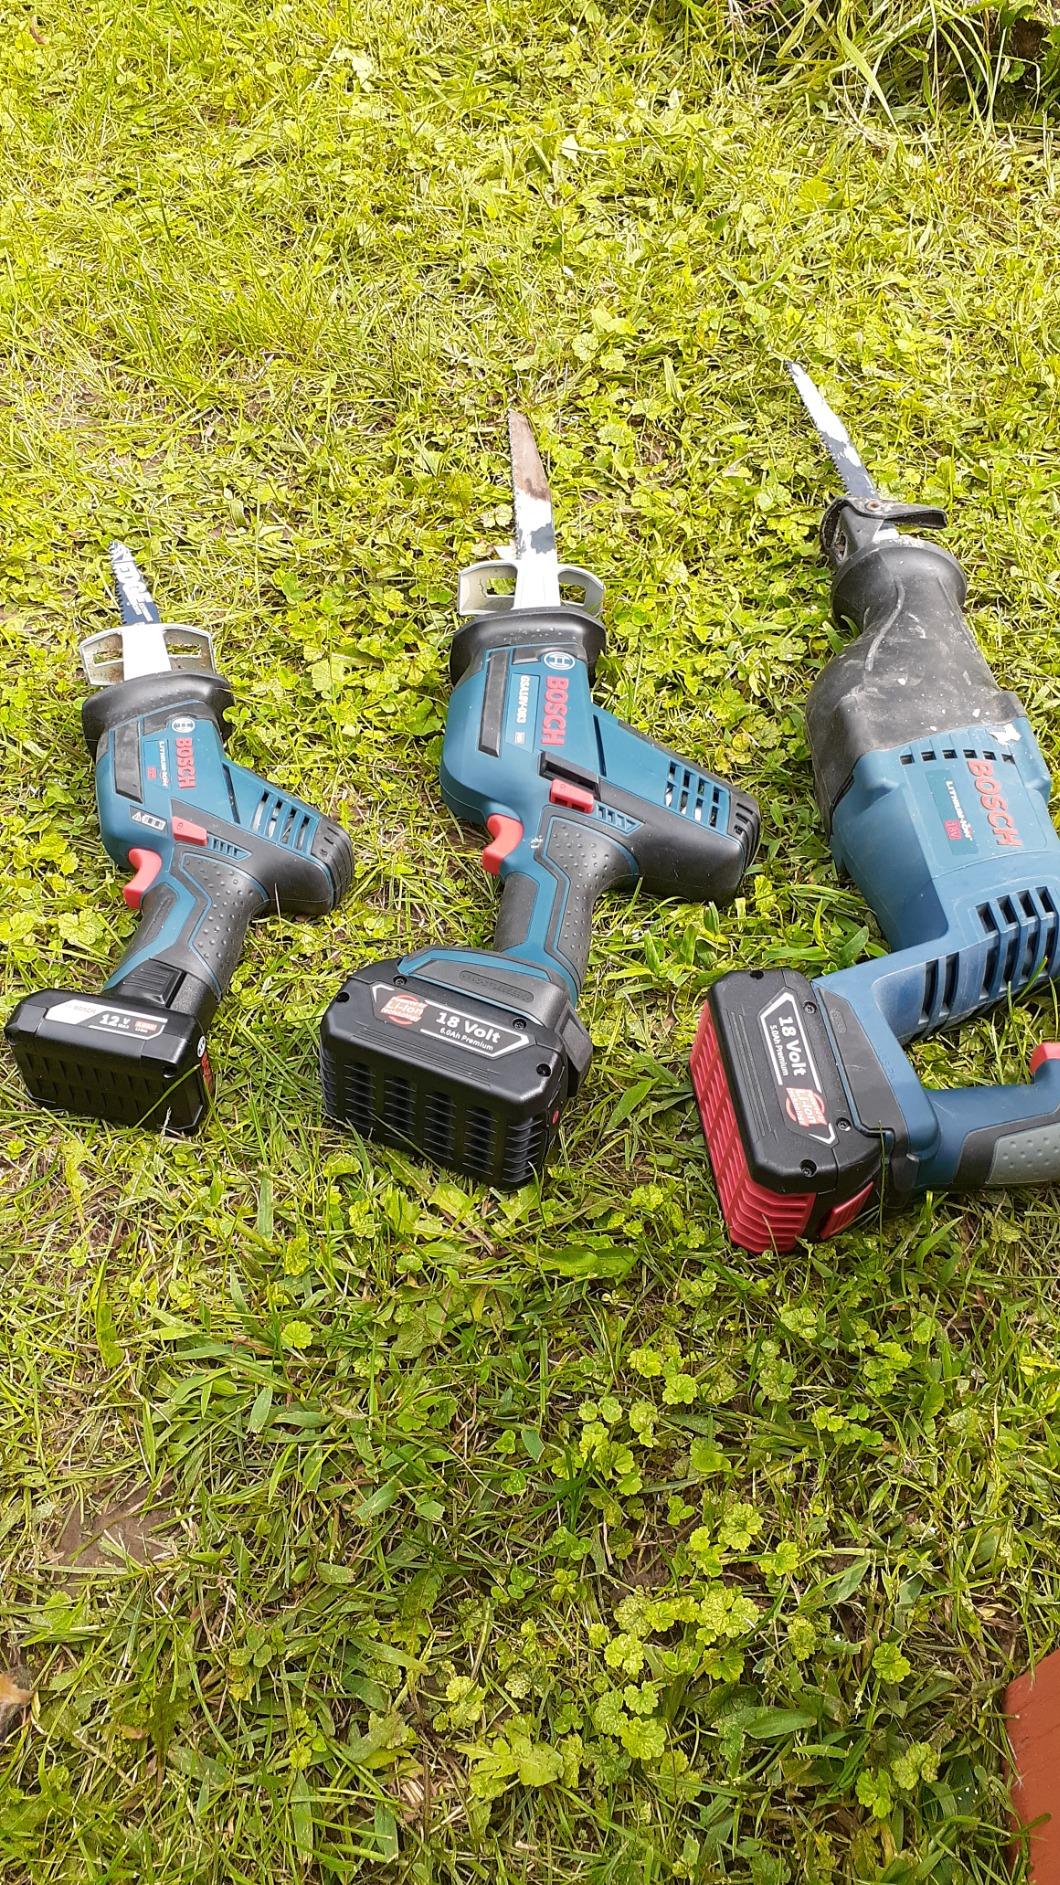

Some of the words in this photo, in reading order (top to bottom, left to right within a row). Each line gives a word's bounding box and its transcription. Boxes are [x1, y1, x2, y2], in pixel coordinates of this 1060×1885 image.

[541, 677, 569, 745] BOSCH
[176, 737, 196, 789] BOSCH
[967, 759, 1023, 847] BOSCH
[99, 1013, 120, 1027] 12
[435, 1012, 460, 1028] 18
[463, 1018, 501, 1043] Volt
[779, 1016, 796, 1037] 18
[461, 1033, 494, 1052] Premium
[770, 1025, 780, 1044] 5.0Ah
[776, 1044, 788, 1076] Premium
[786, 1039, 807, 1076] Volt
